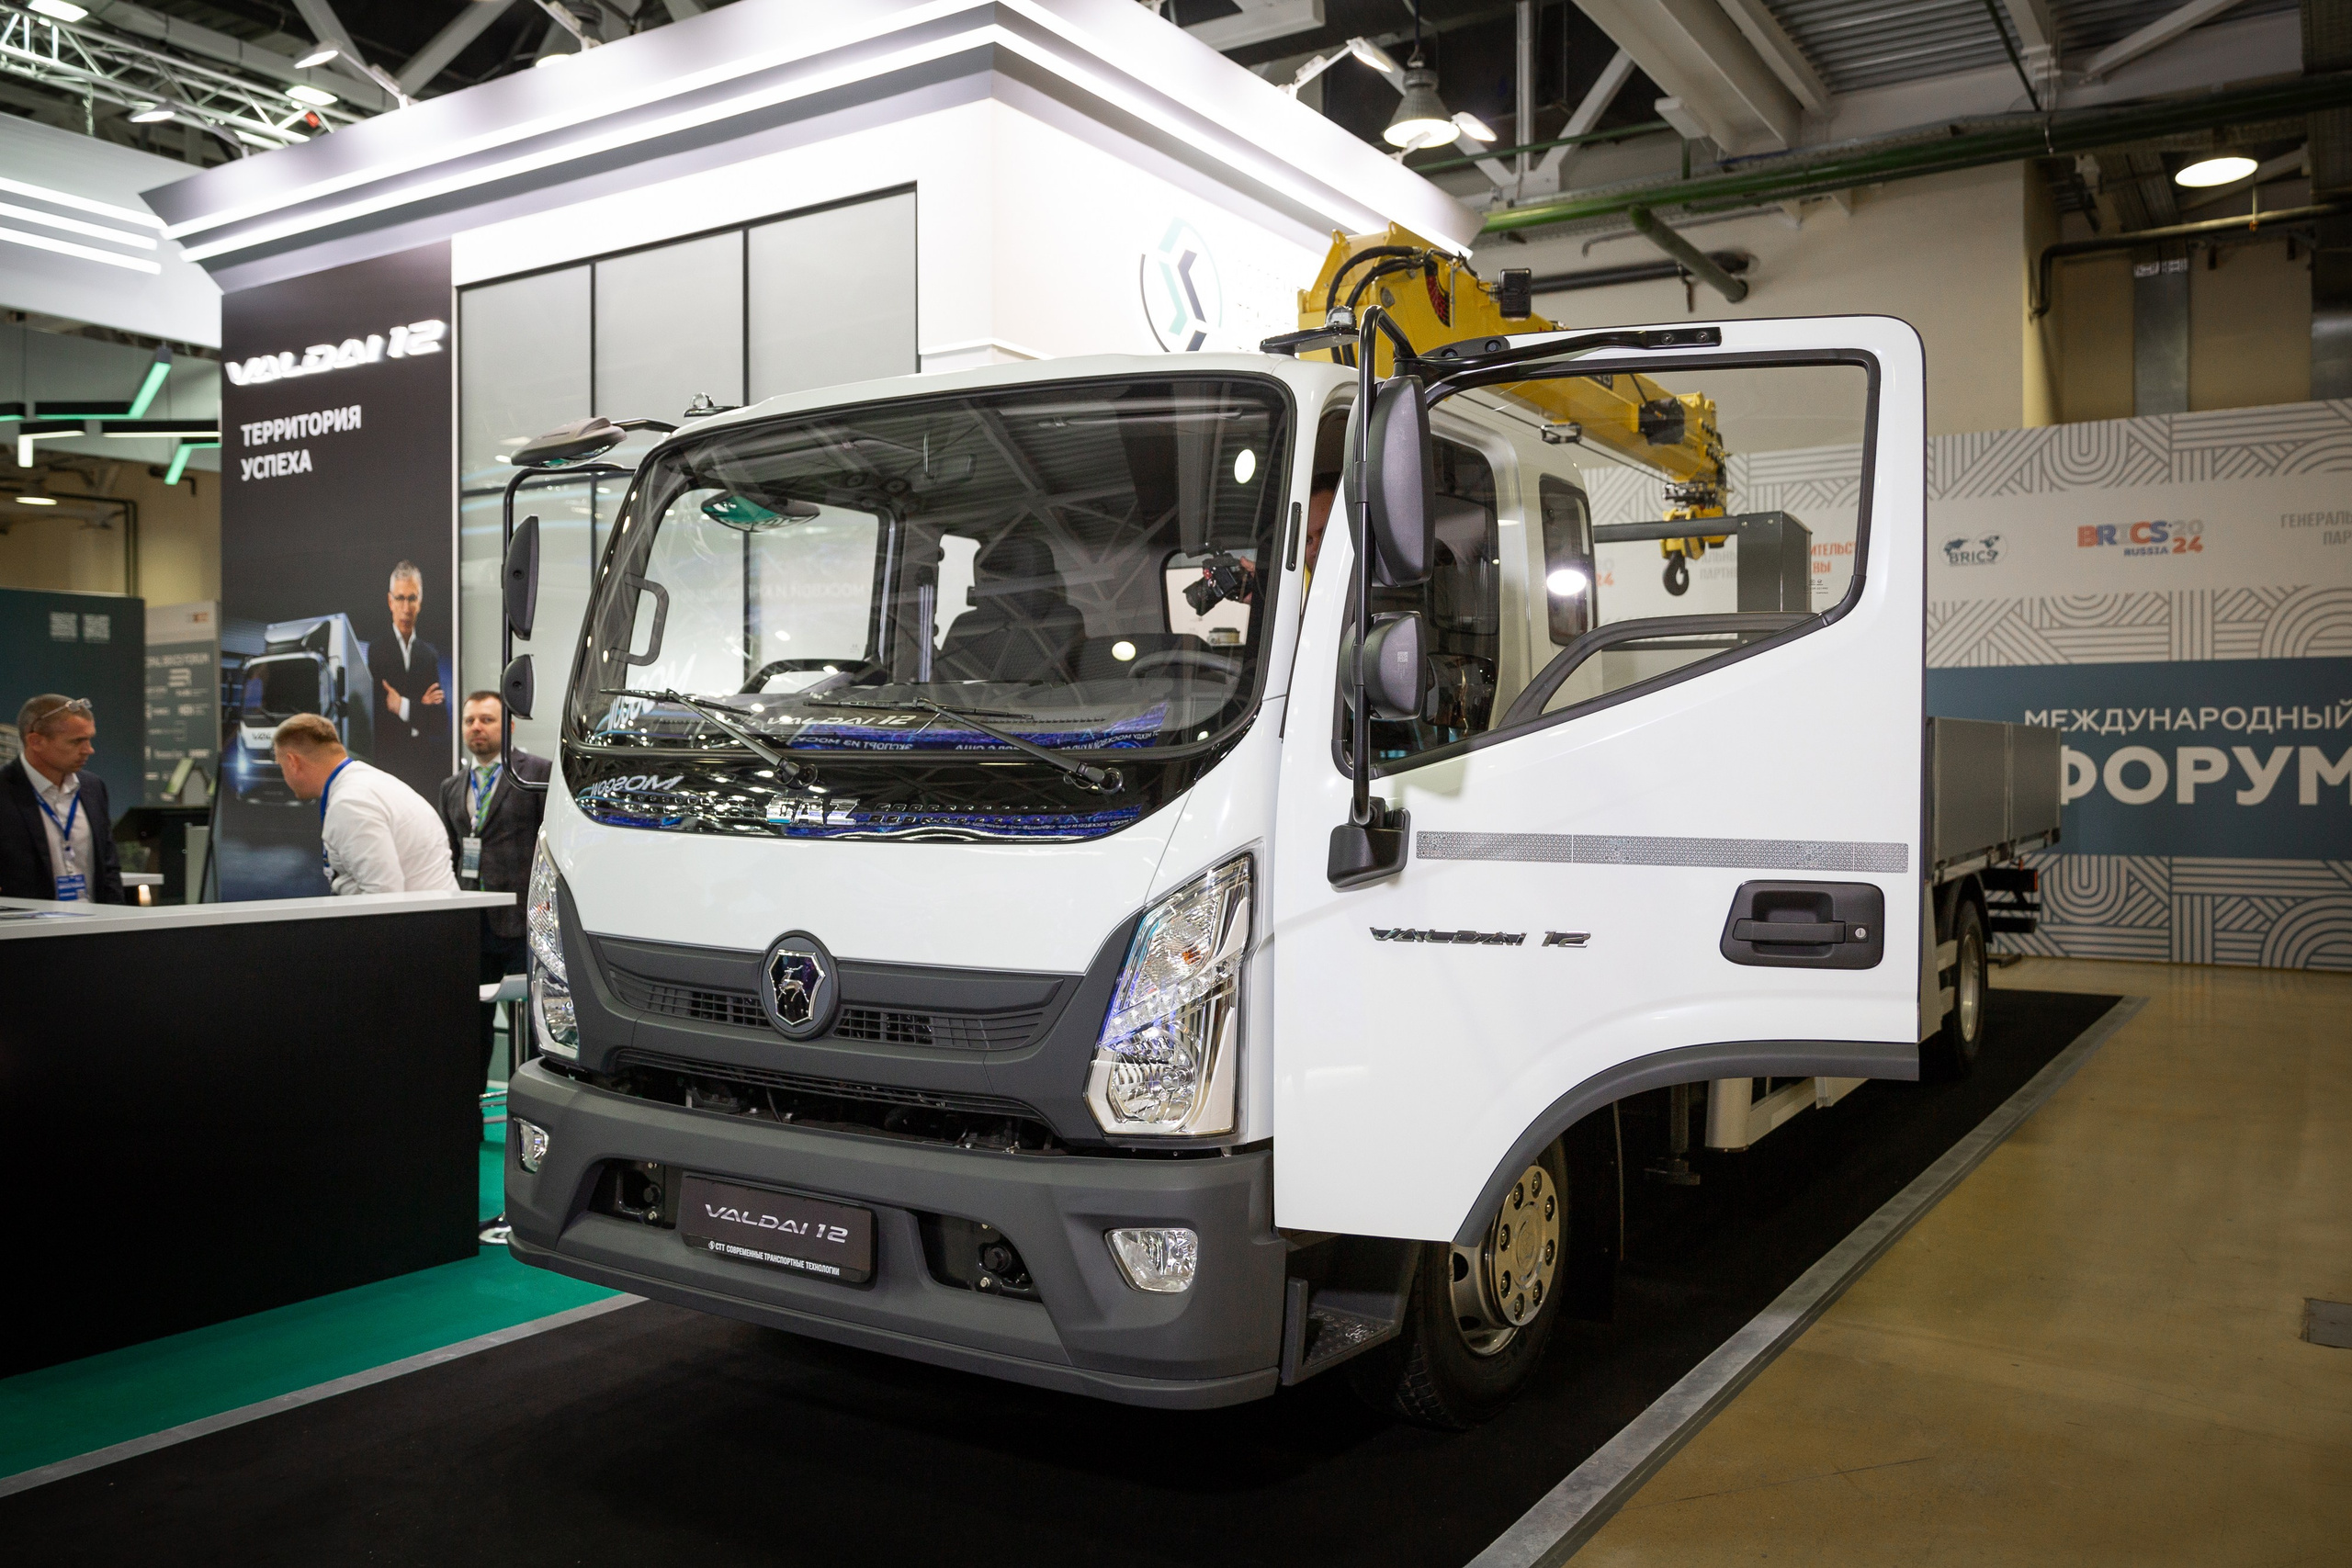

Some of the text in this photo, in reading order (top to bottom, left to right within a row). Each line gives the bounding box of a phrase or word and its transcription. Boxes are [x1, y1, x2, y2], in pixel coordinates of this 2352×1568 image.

[225, 319, 446, 386] VALDAI 12
[241, 404, 362, 447] ТЕРРИТОРИЯ
[241, 448, 313, 481] УСПЕХА
[2077, 520, 2169, 548] BRICS
[2172, 536, 2203, 554] 24
[1949, 549, 1997, 563] BRICS
[2123, 546, 2169, 557] RUSSIA
[878, 715, 917, 725] 12
[2025, 698, 2352, 735] МЕЖДУНАРОДНЫЙ
[1369, 926, 1591, 949] VALDAI 12
[705, 1203, 849, 1244] VALDAI 12
[715, 1241, 840, 1277] СТТ СОВРЕМЕННЫЕ ТРАНСПОРТНЫЕ ТЕХНОЛОГИИ
